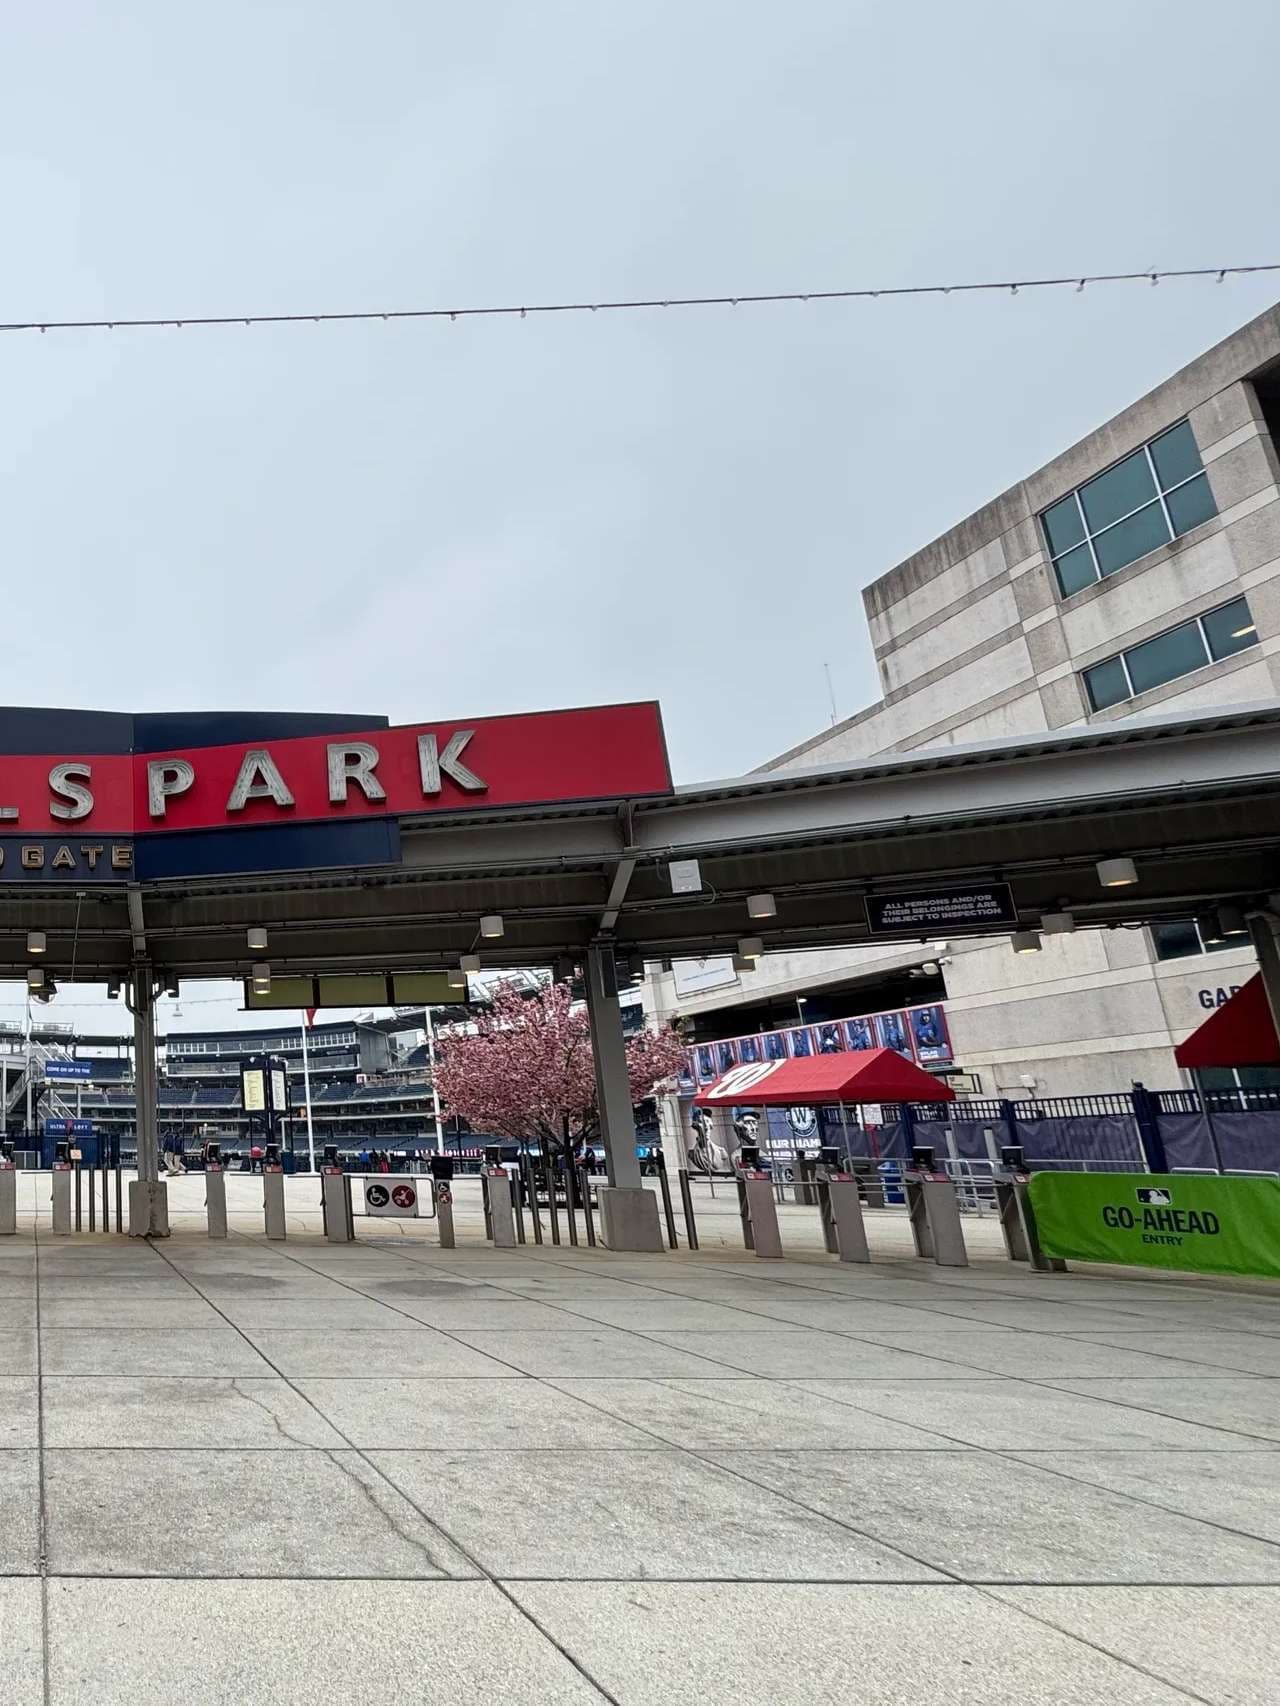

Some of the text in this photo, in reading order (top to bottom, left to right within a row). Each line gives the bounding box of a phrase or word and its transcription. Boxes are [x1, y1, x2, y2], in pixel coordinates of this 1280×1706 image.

[147, 729, 489, 818] PARK
[21, 844, 134, 870] GATE
[882, 900, 998, 917] THEIR BELONGINGS ARE
[904, 898, 950, 908] PERSONS
[951, 894, 993, 904] AND/OR
[881, 907, 1002, 924] SUBJECT TO INSPECTION
[1102, 1205, 1221, 1236] GO-AHEAD
[1141, 1234, 1184, 1246] ENTRY
